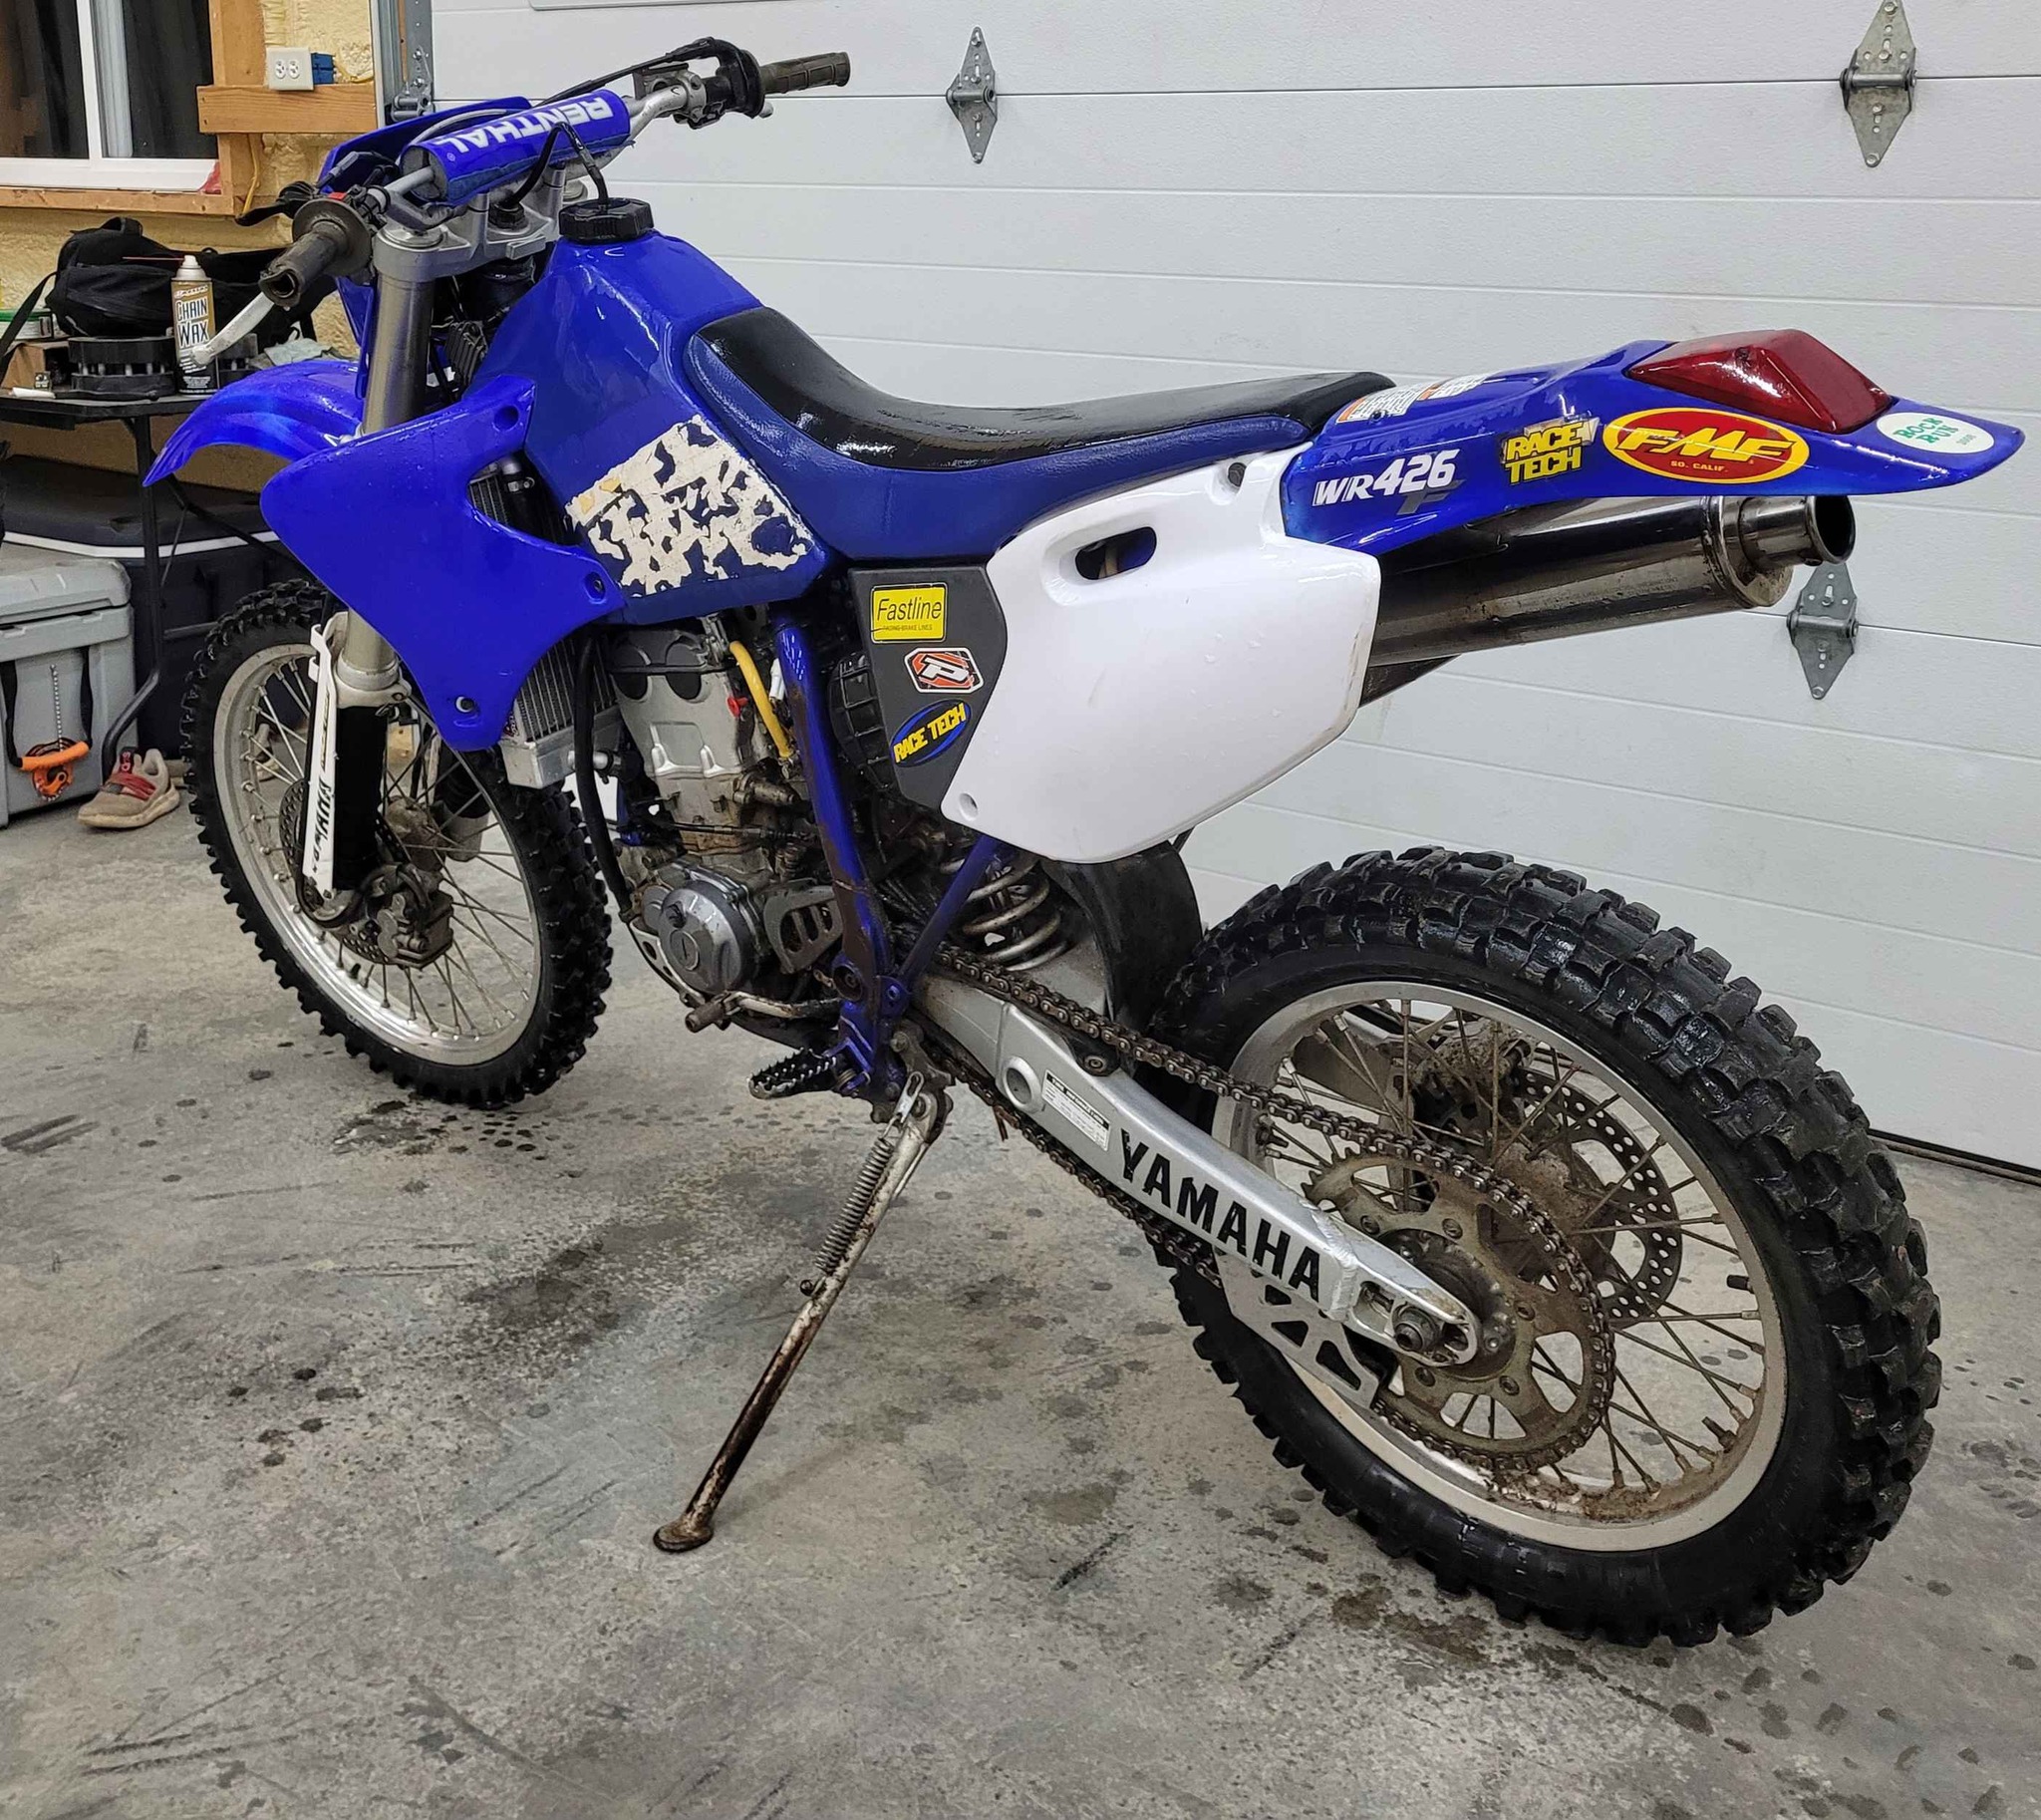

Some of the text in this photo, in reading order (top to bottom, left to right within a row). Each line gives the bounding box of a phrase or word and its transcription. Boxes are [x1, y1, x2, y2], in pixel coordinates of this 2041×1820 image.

[436, 97, 614, 153] RENTHAL
[175, 298, 208, 323] CHAIN
[177, 320, 209, 349] WAX
[1506, 423, 1585, 459] RACE
[1615, 427, 1796, 462] FMF
[1893, 418, 1943, 439] ROCK
[1915, 425, 1958, 444] RUN
[1312, 449, 1460, 506] WR426
[1505, 447, 1583, 483] TECH
[1692, 461, 1728, 472] CALIF.
[877, 596, 942, 621] Fastline
[893, 702, 967, 763] RACE TECH
[1120, 1127, 1320, 1303] YAMAHA
